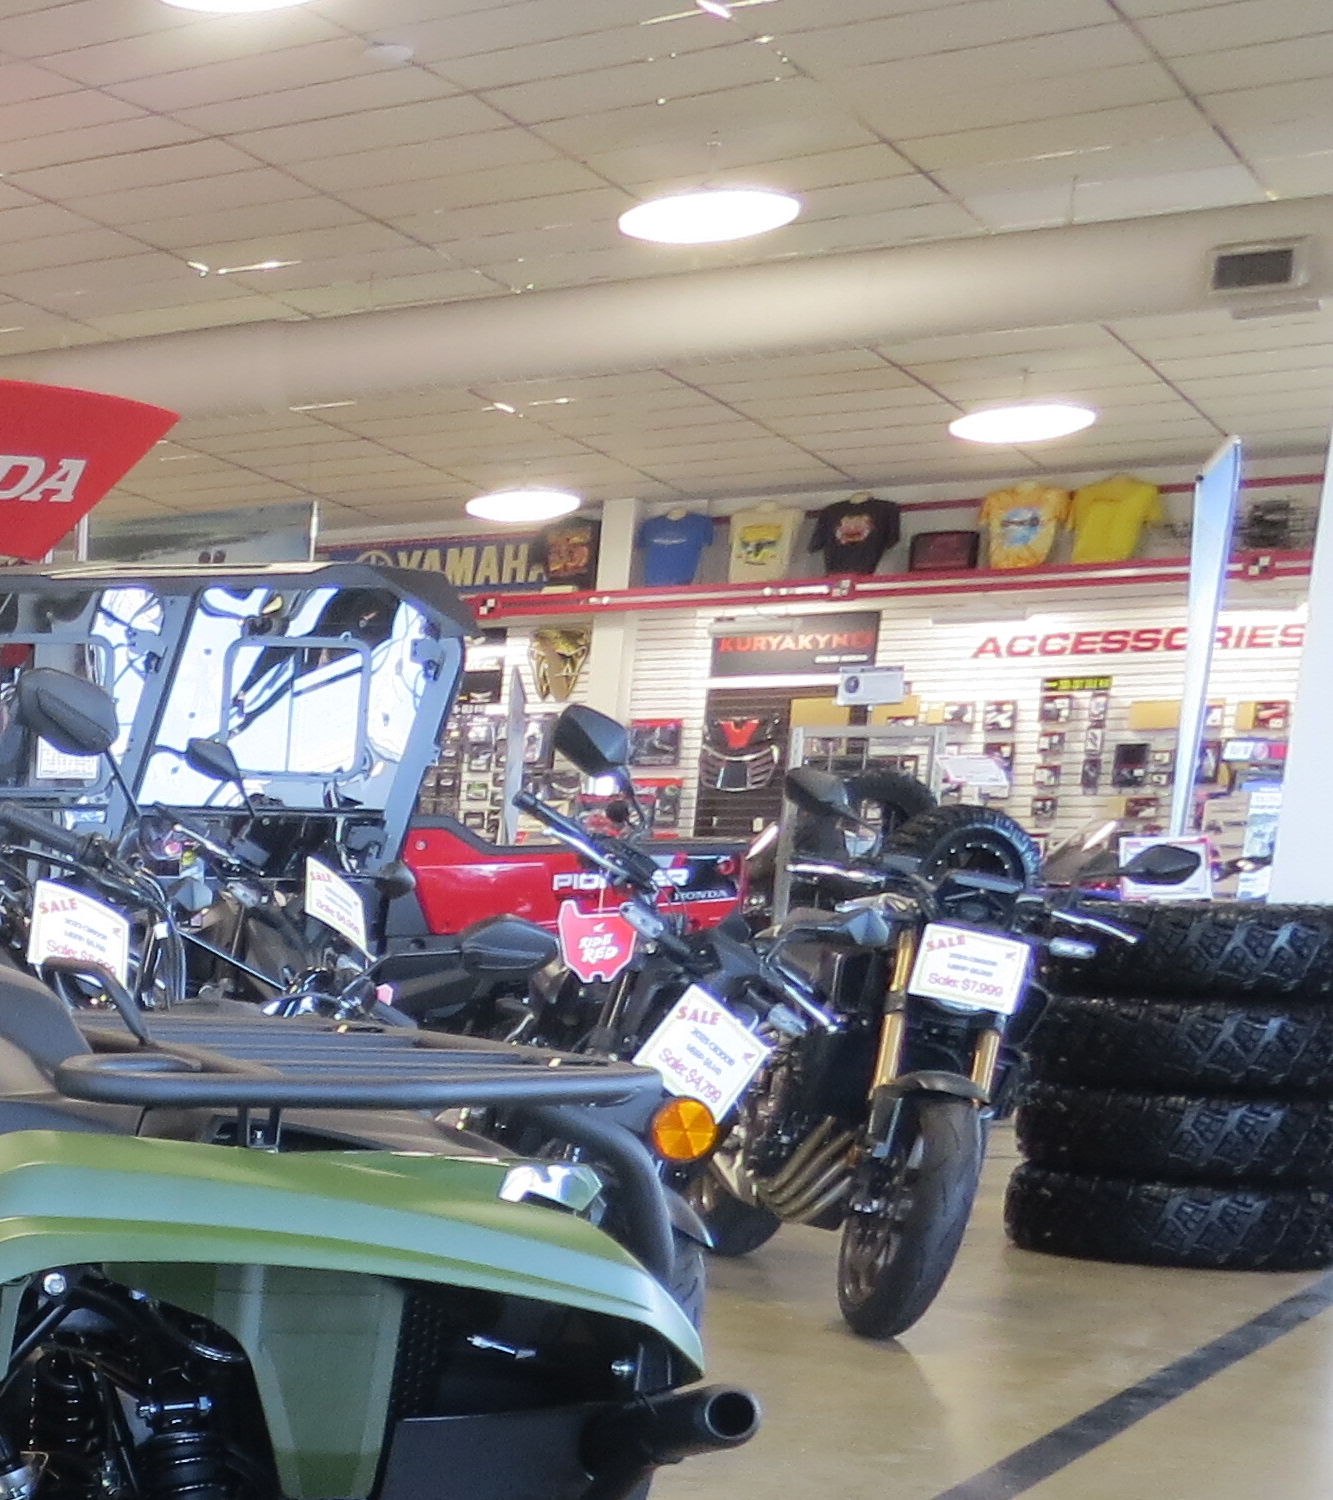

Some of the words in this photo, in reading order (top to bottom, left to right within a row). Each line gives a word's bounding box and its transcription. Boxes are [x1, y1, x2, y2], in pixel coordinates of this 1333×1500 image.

[552, 867, 691, 891] PIOER
[674, 889, 729, 901] HONDA
[38, 898, 79, 915] SALE
[926, 934, 966, 953] SALE
[675, 1005, 722, 1027] SALE
